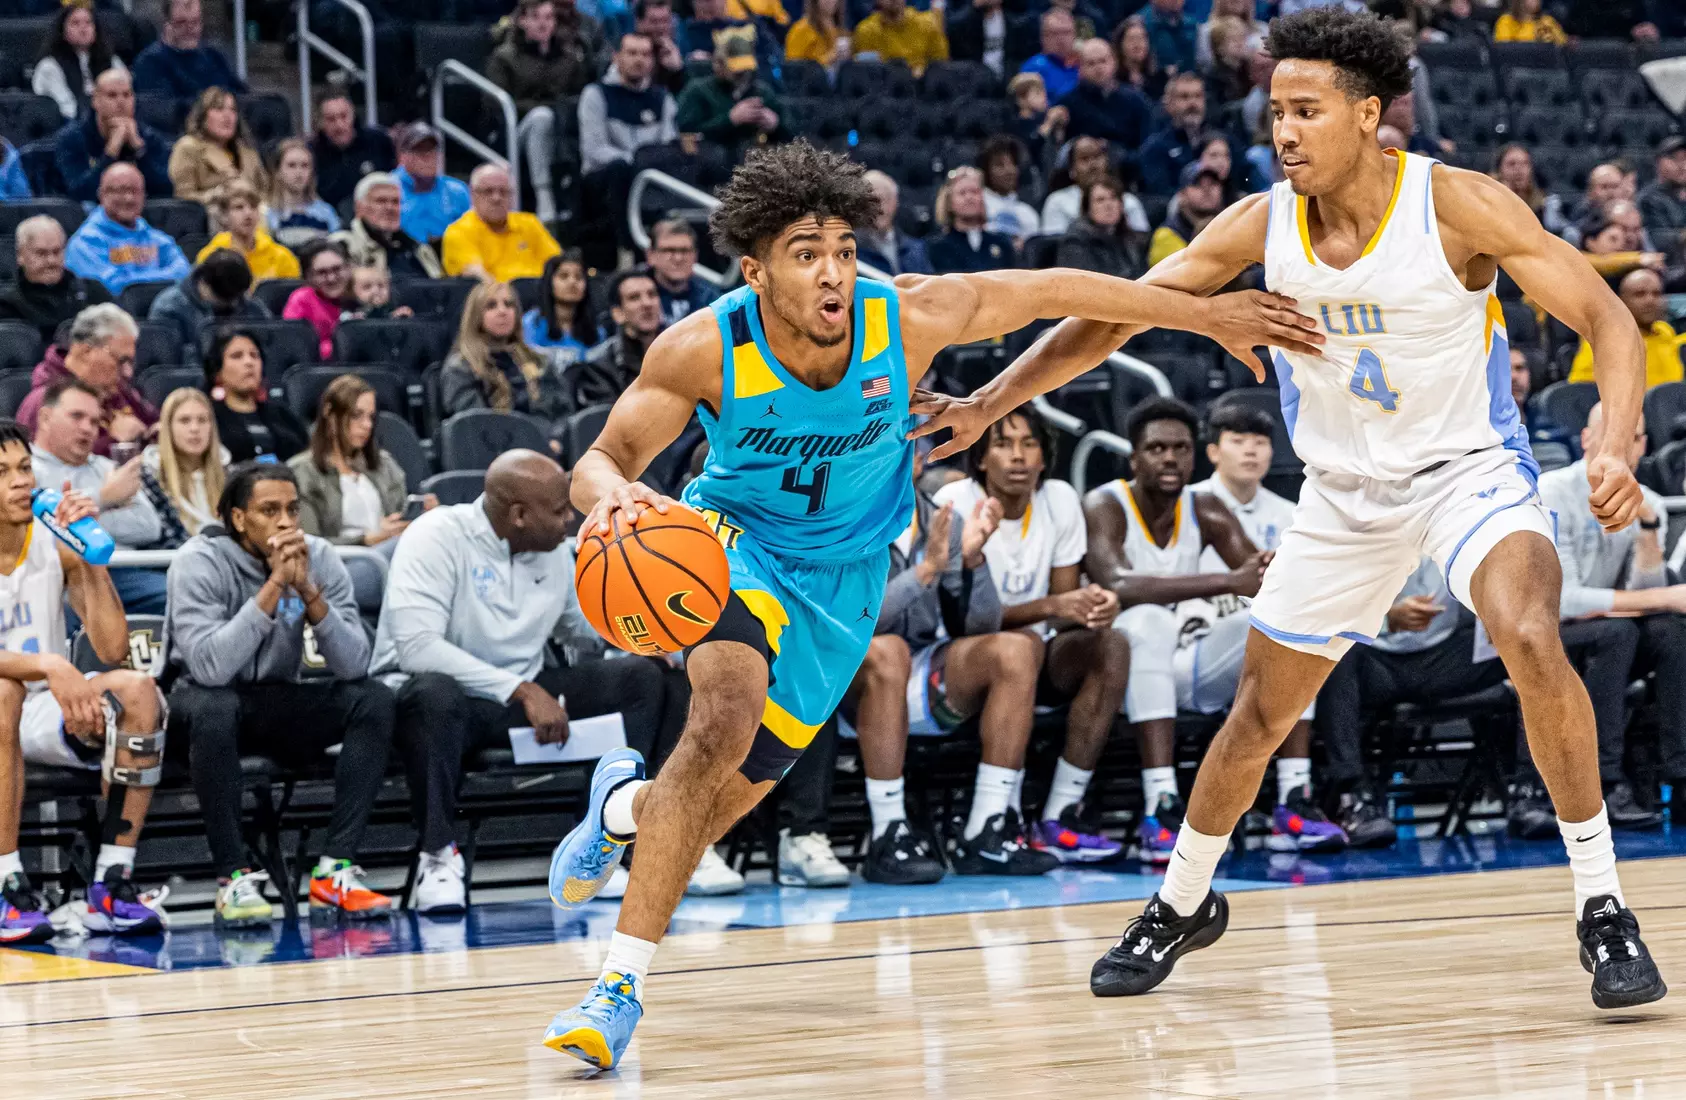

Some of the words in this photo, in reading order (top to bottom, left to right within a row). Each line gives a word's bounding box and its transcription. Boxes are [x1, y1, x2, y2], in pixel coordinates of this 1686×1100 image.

[1319, 302, 1387, 335] LIU
[1346, 344, 1402, 414] 4
[735, 417, 891, 465] Marquette
[779, 461, 831, 516] 4
[620, 613, 666, 655] ELIT
